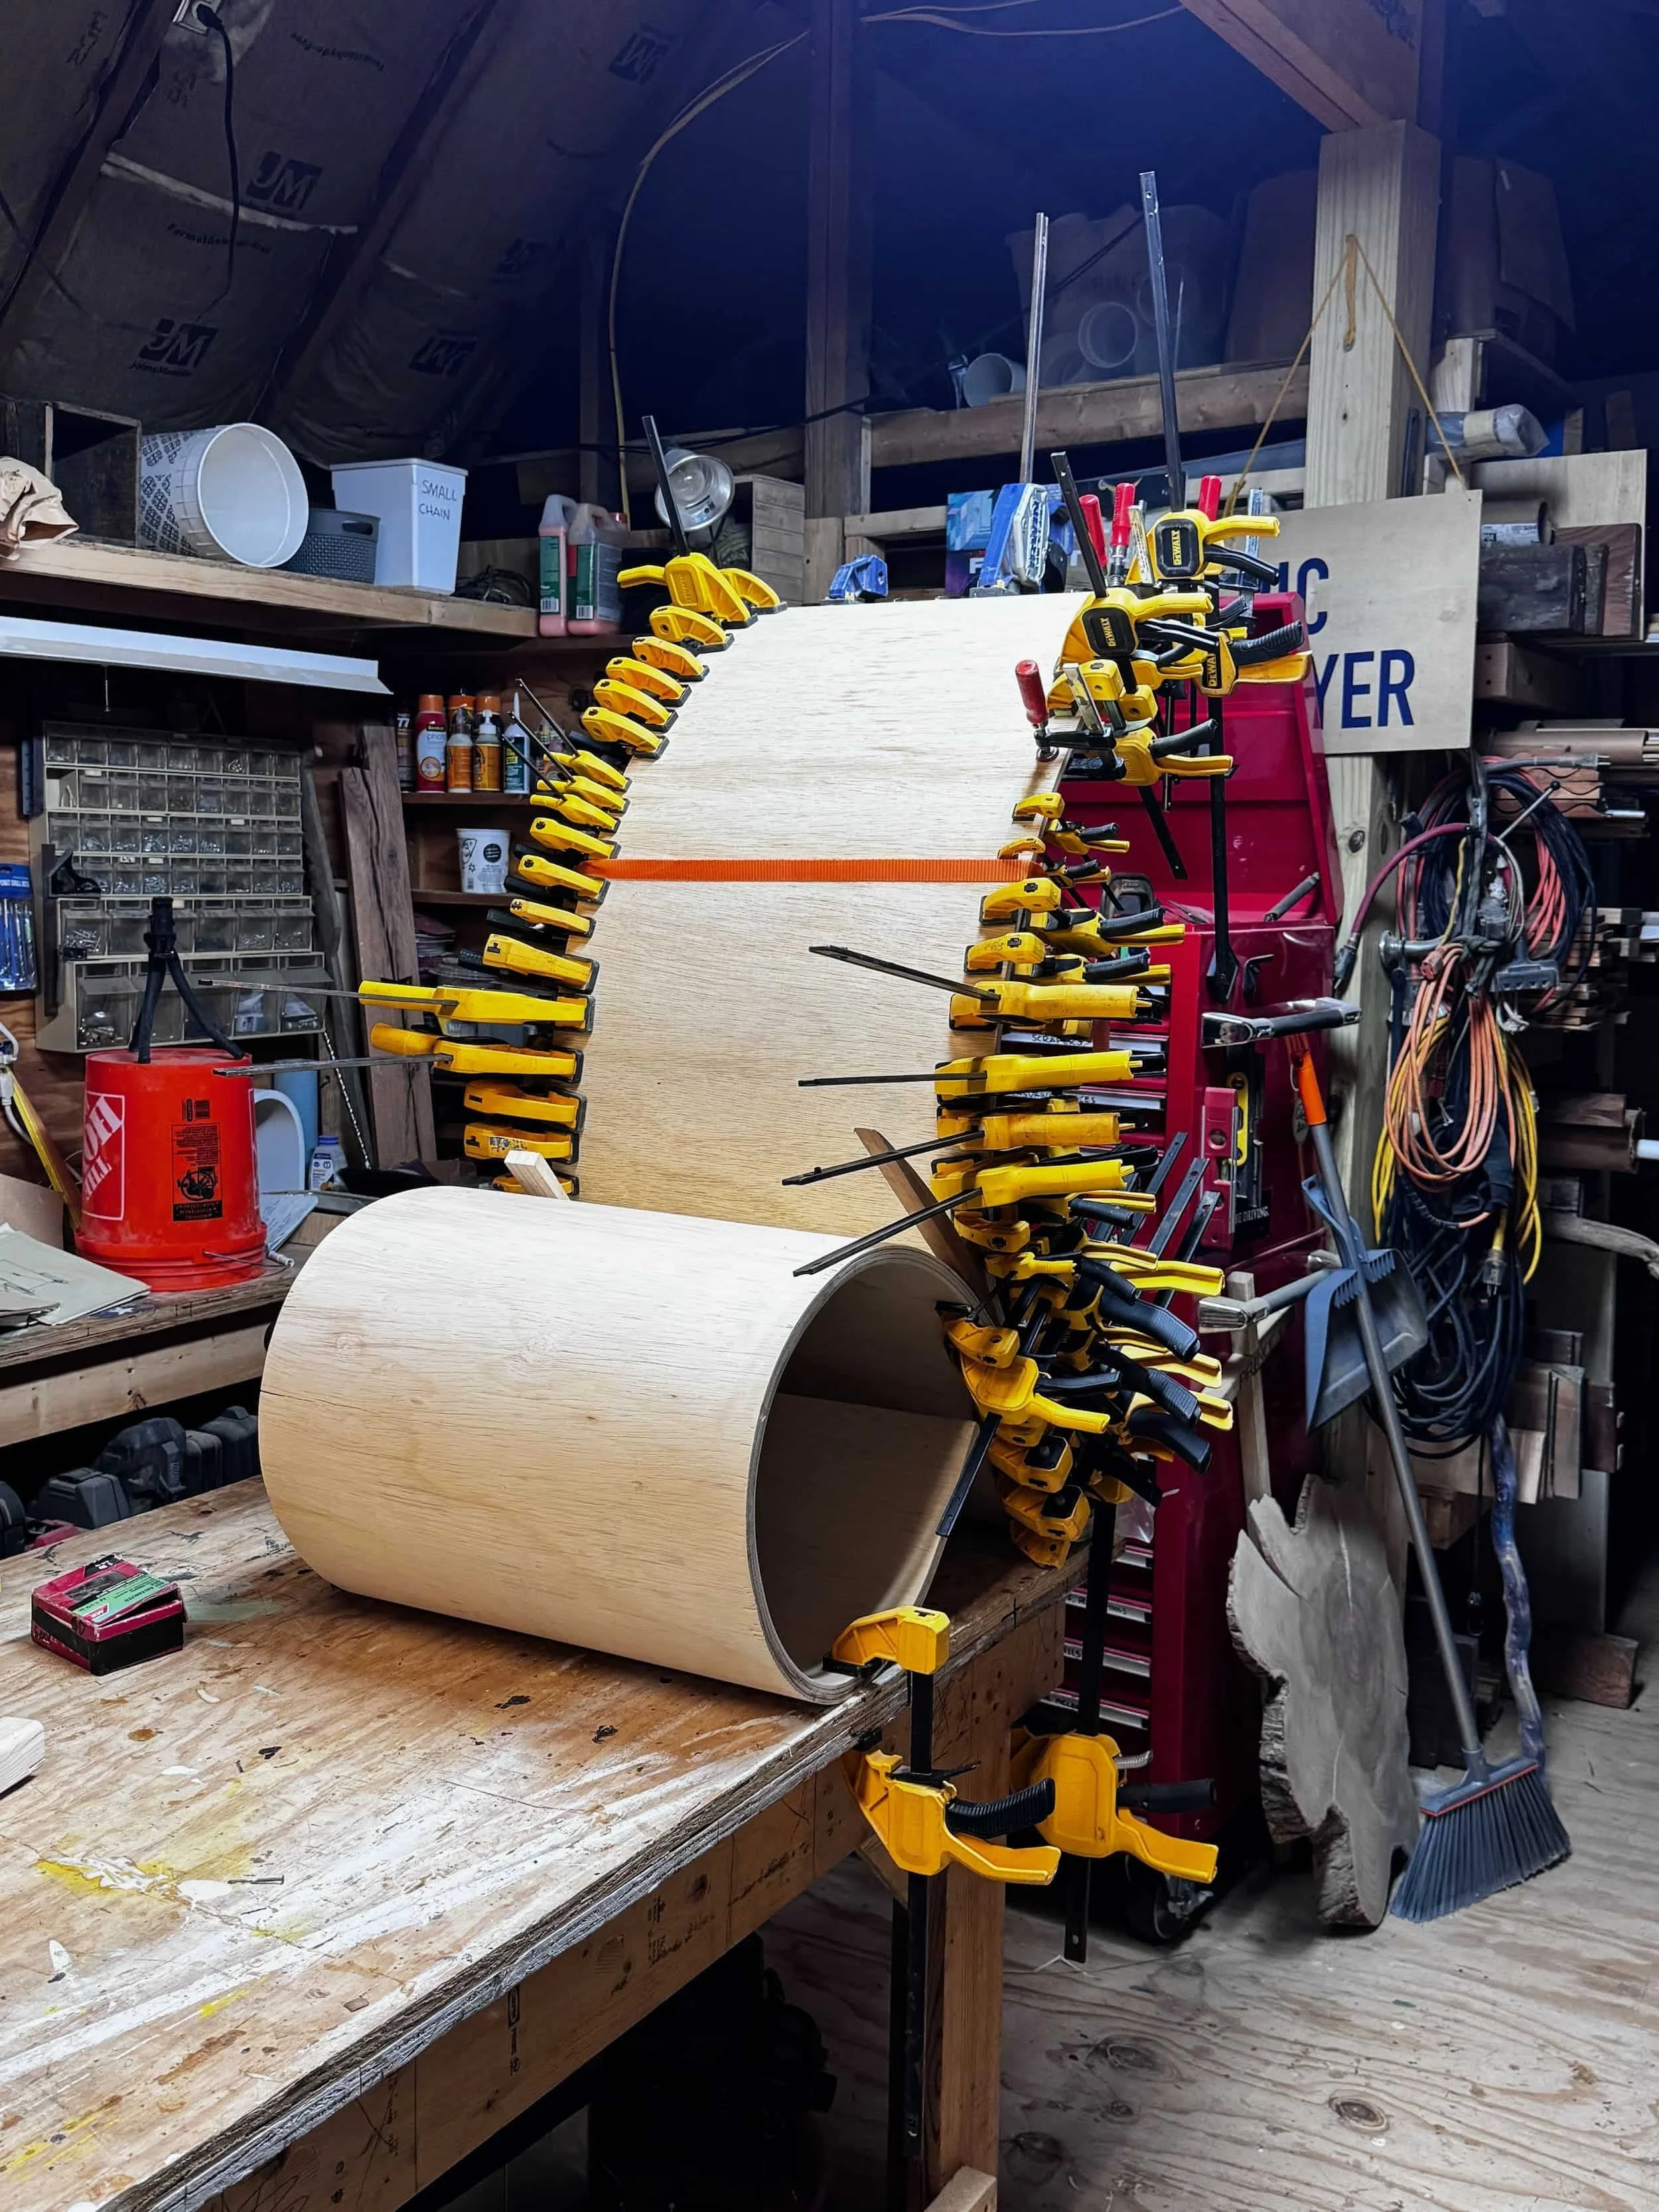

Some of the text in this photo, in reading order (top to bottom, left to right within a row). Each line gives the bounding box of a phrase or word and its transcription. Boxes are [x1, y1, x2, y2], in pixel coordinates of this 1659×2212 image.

[246, 151, 323, 210] JM
[139, 318, 219, 367] JM
[422, 480, 457, 501] SMALL
[419, 503, 451, 521] CHAIN
[1171, 529, 1183, 566] DEWALT
[1100, 617, 1117, 647] DEWALT
[1206, 652, 1218, 687] DEWA
[1311, 649, 1415, 730] YER
[397, 718, 410, 728] 77
[84, 1096, 122, 1162] HO
